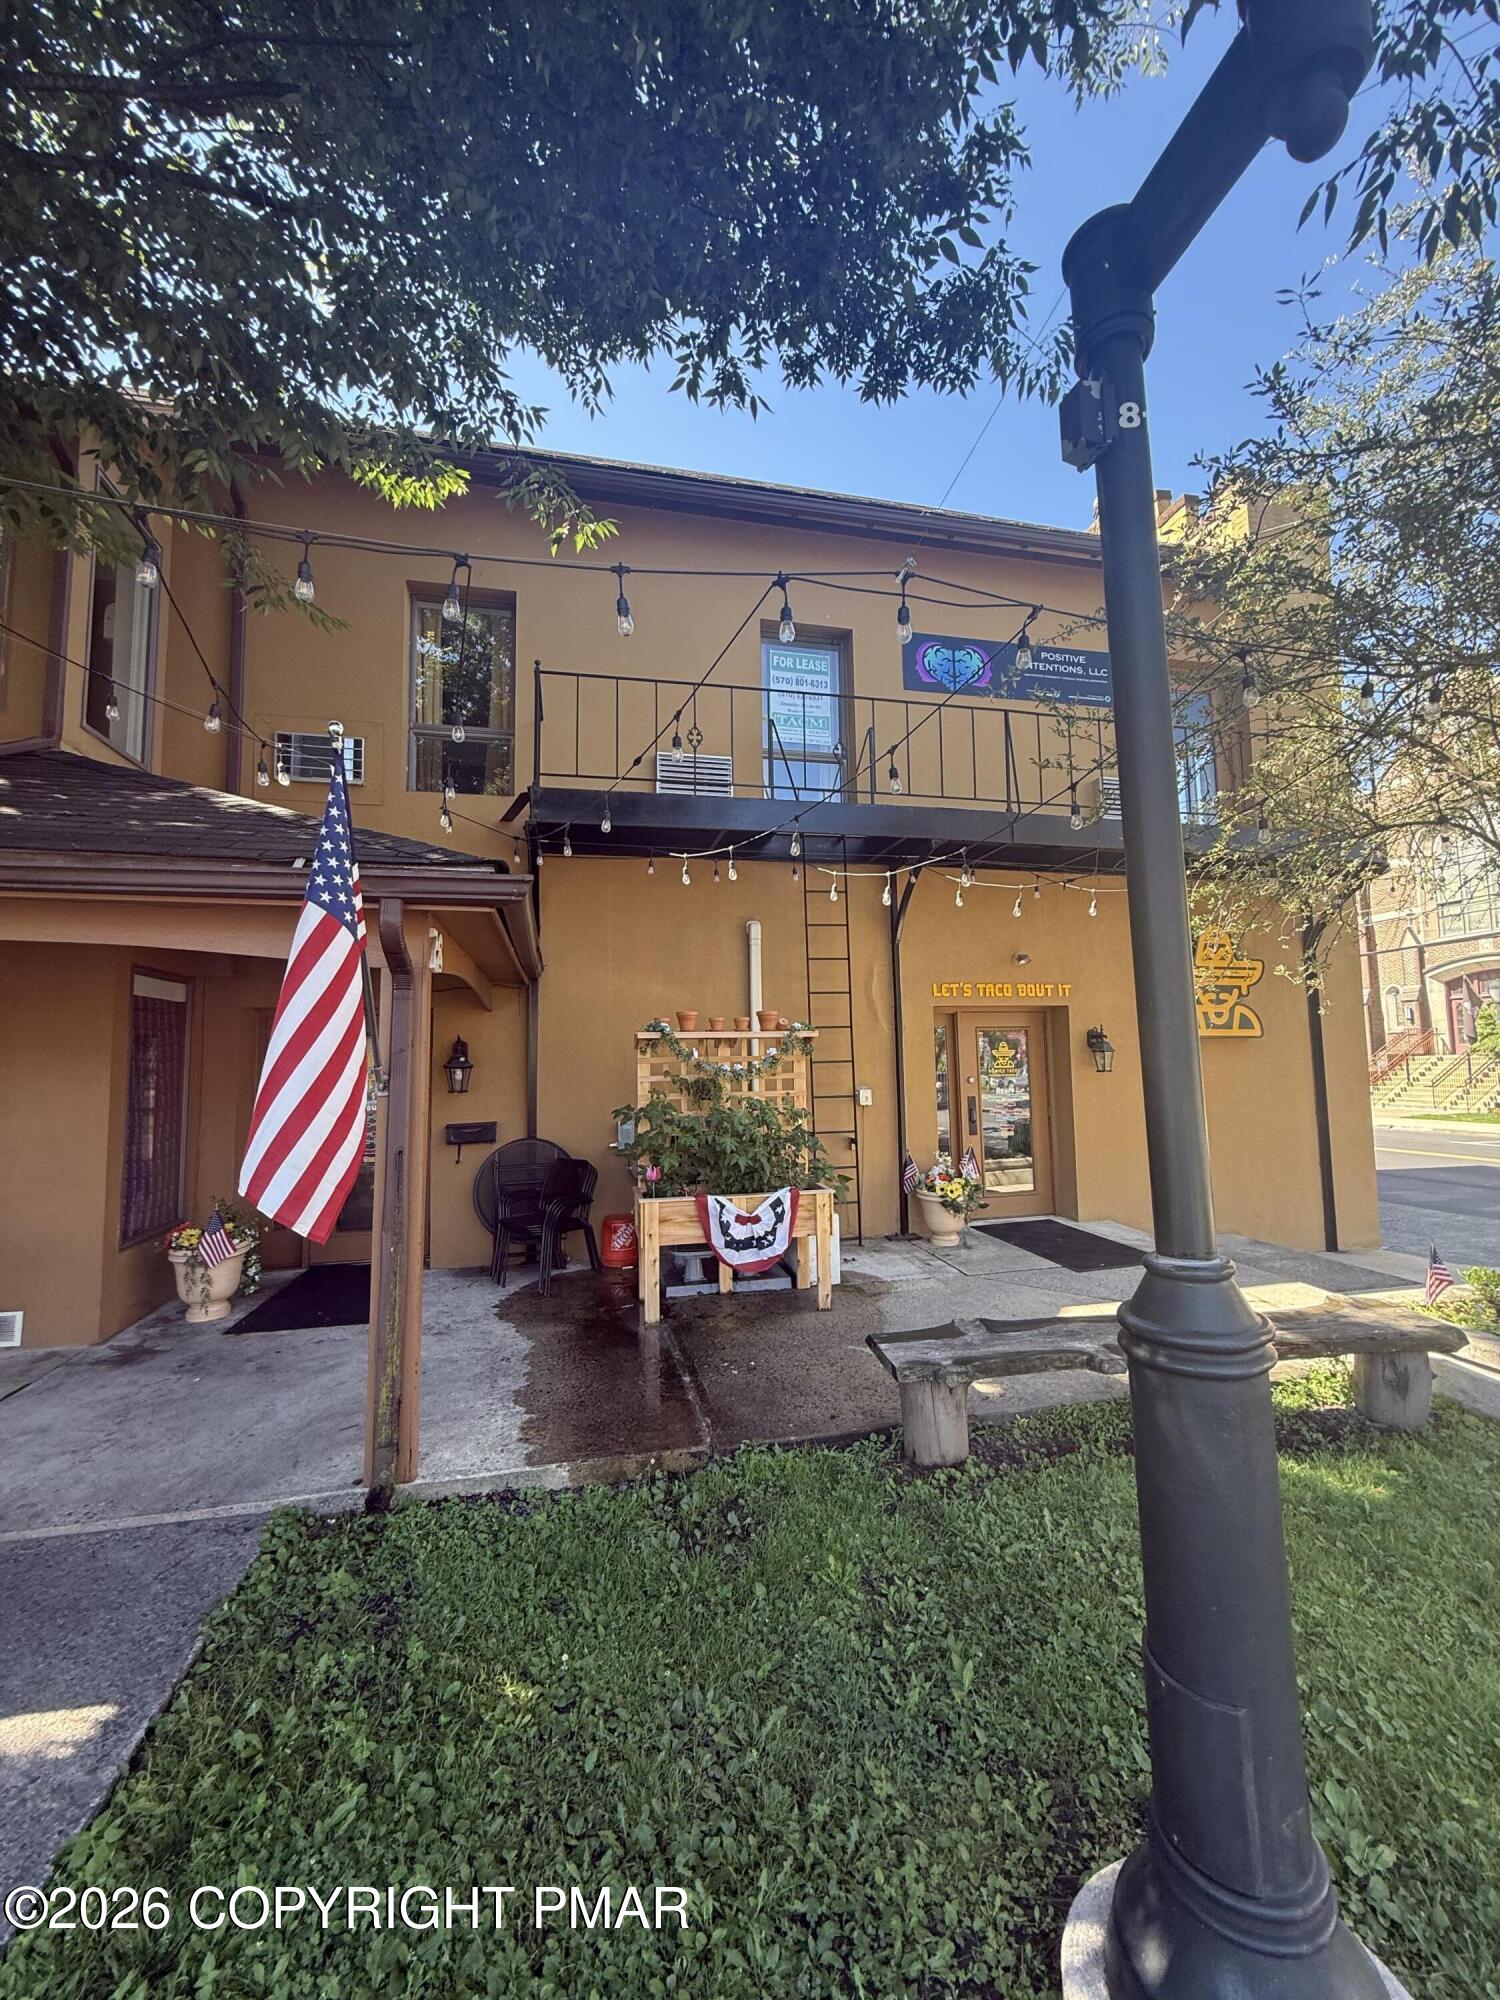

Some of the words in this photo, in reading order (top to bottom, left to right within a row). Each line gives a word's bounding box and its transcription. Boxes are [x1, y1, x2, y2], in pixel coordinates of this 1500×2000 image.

[773, 655, 793, 668] FOR
[796, 657, 828, 672] LEASE
[1041, 652, 1086, 664] POSITIVE
[1024, 661, 1086, 676] NTENTIONS,
[1088, 667, 1108, 677] LLC
[772, 674, 794, 687] (570)
[932, 982, 972, 997] LET'S
[976, 983, 1012, 997] TACO
[1058, 984, 1072, 997] IT
